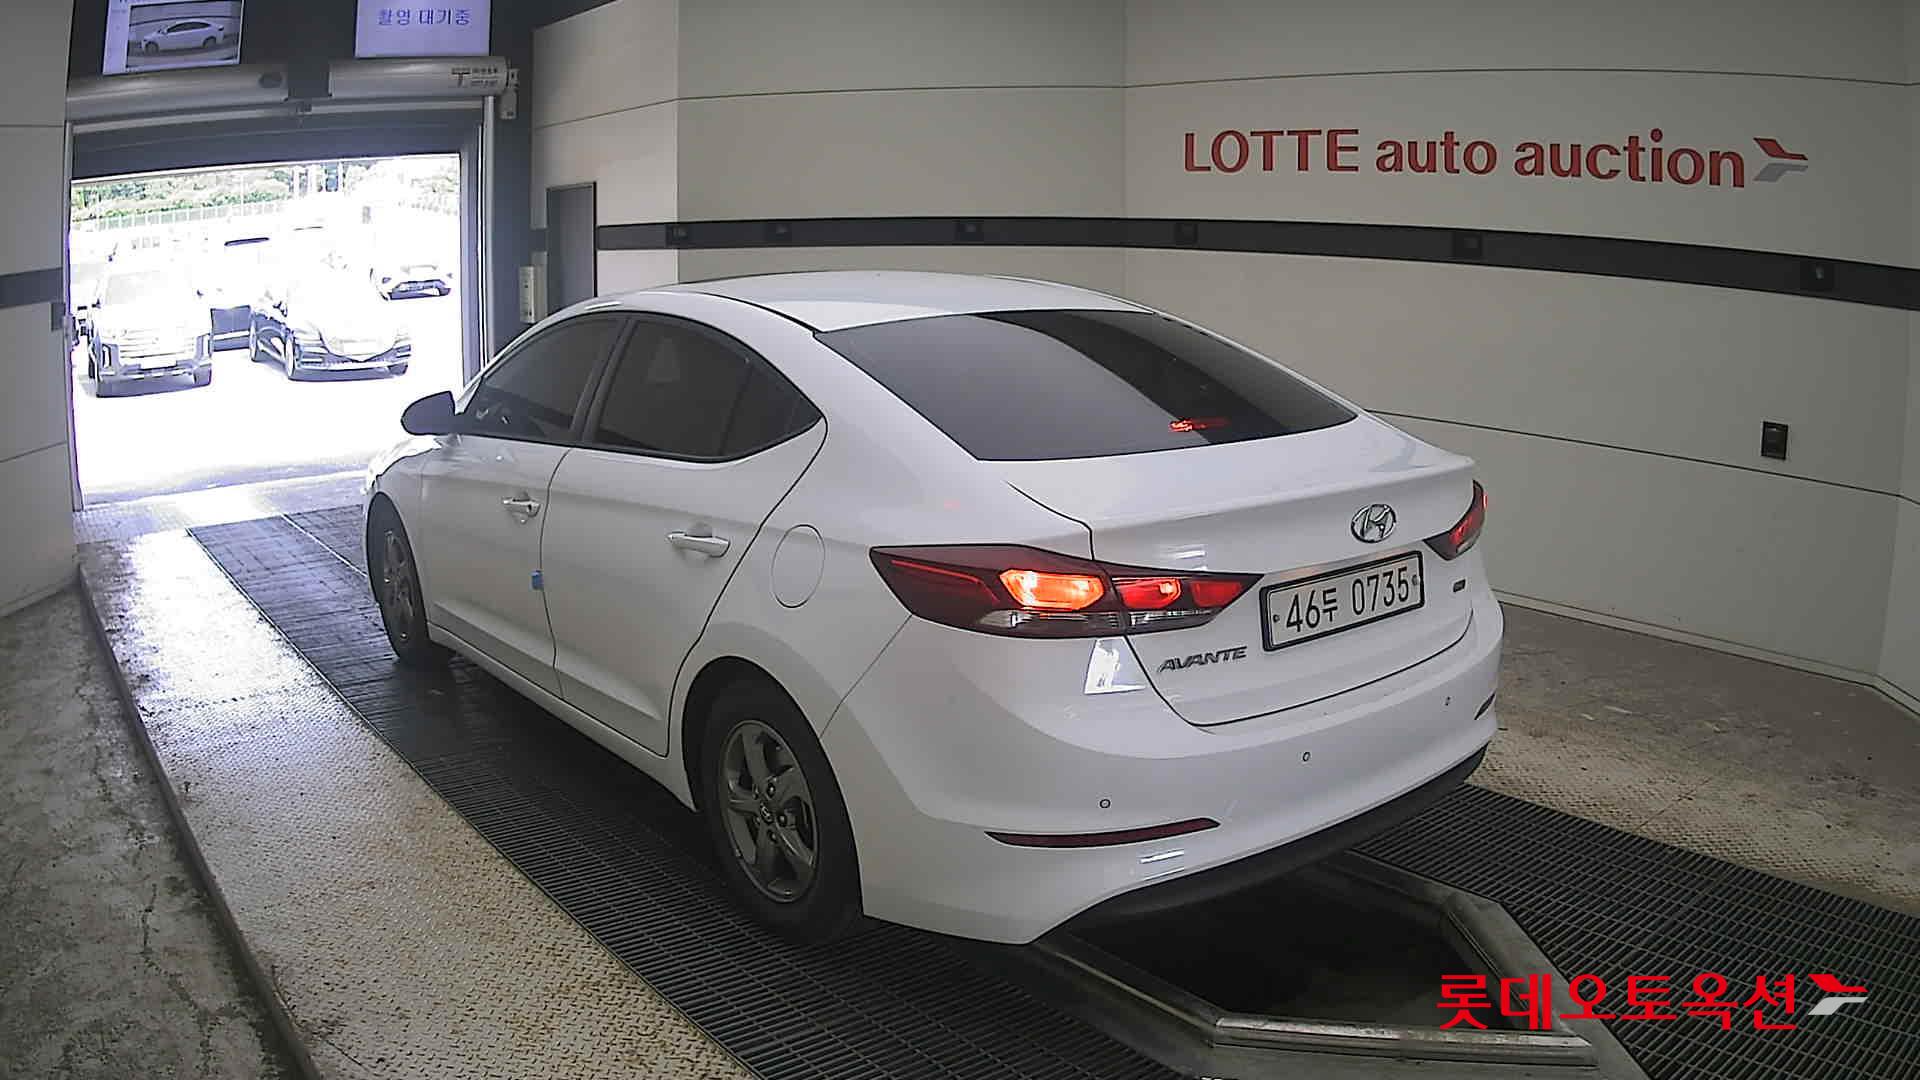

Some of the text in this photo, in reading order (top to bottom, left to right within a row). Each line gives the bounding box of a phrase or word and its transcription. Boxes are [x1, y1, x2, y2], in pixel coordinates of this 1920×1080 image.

[419, 8, 470, 26] 대기중
[1184, 128, 1745, 188] LOTTE auto auction
[1286, 566, 1409, 632] 46두 0735
[1157, 646, 1248, 673] AVANTE
